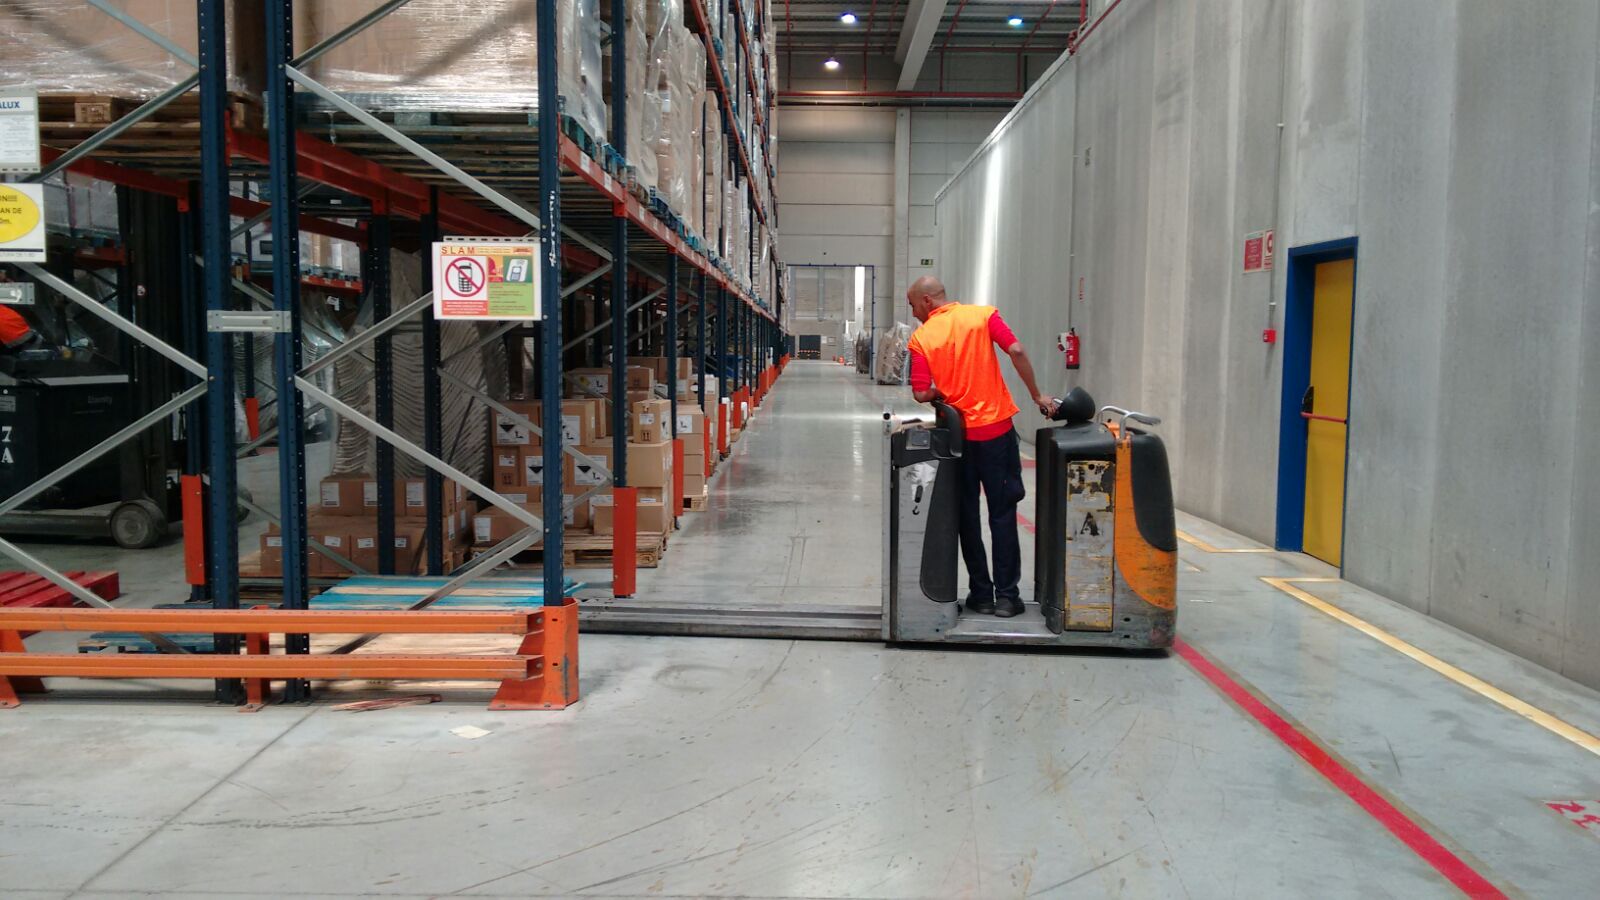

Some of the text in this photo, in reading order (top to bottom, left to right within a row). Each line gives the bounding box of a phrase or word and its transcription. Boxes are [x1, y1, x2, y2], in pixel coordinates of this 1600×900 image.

[441, 247, 475, 255] SLAM
[1, 425, 12, 442] 7
[1, 447, 14, 463] A
[1080, 511, 1100, 536] A
